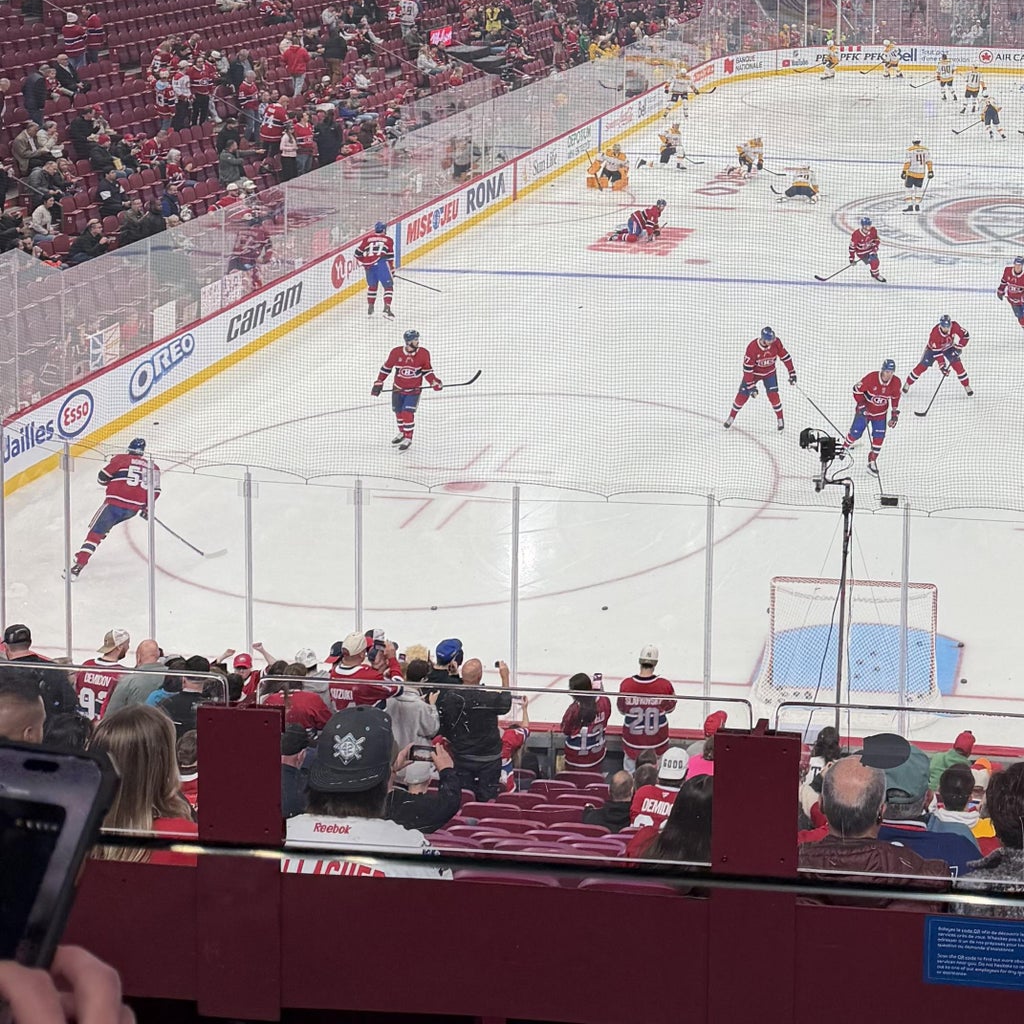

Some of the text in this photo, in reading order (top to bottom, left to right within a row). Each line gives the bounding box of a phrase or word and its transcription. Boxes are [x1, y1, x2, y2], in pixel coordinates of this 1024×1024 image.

[840, 53, 860, 61] PFK
[995, 53, 1011, 61] AIR
[467, 172, 507, 214] RONA
[226, 282, 303, 343] can-am
[130, 333, 195, 403] OREO
[63, 401, 89, 427] Esso
[83, 672, 112, 688] DEMIDOV
[629, 707, 660, 736] 20
[641, 797, 674, 814] DEMID
[313, 822, 351, 835] Reebok
